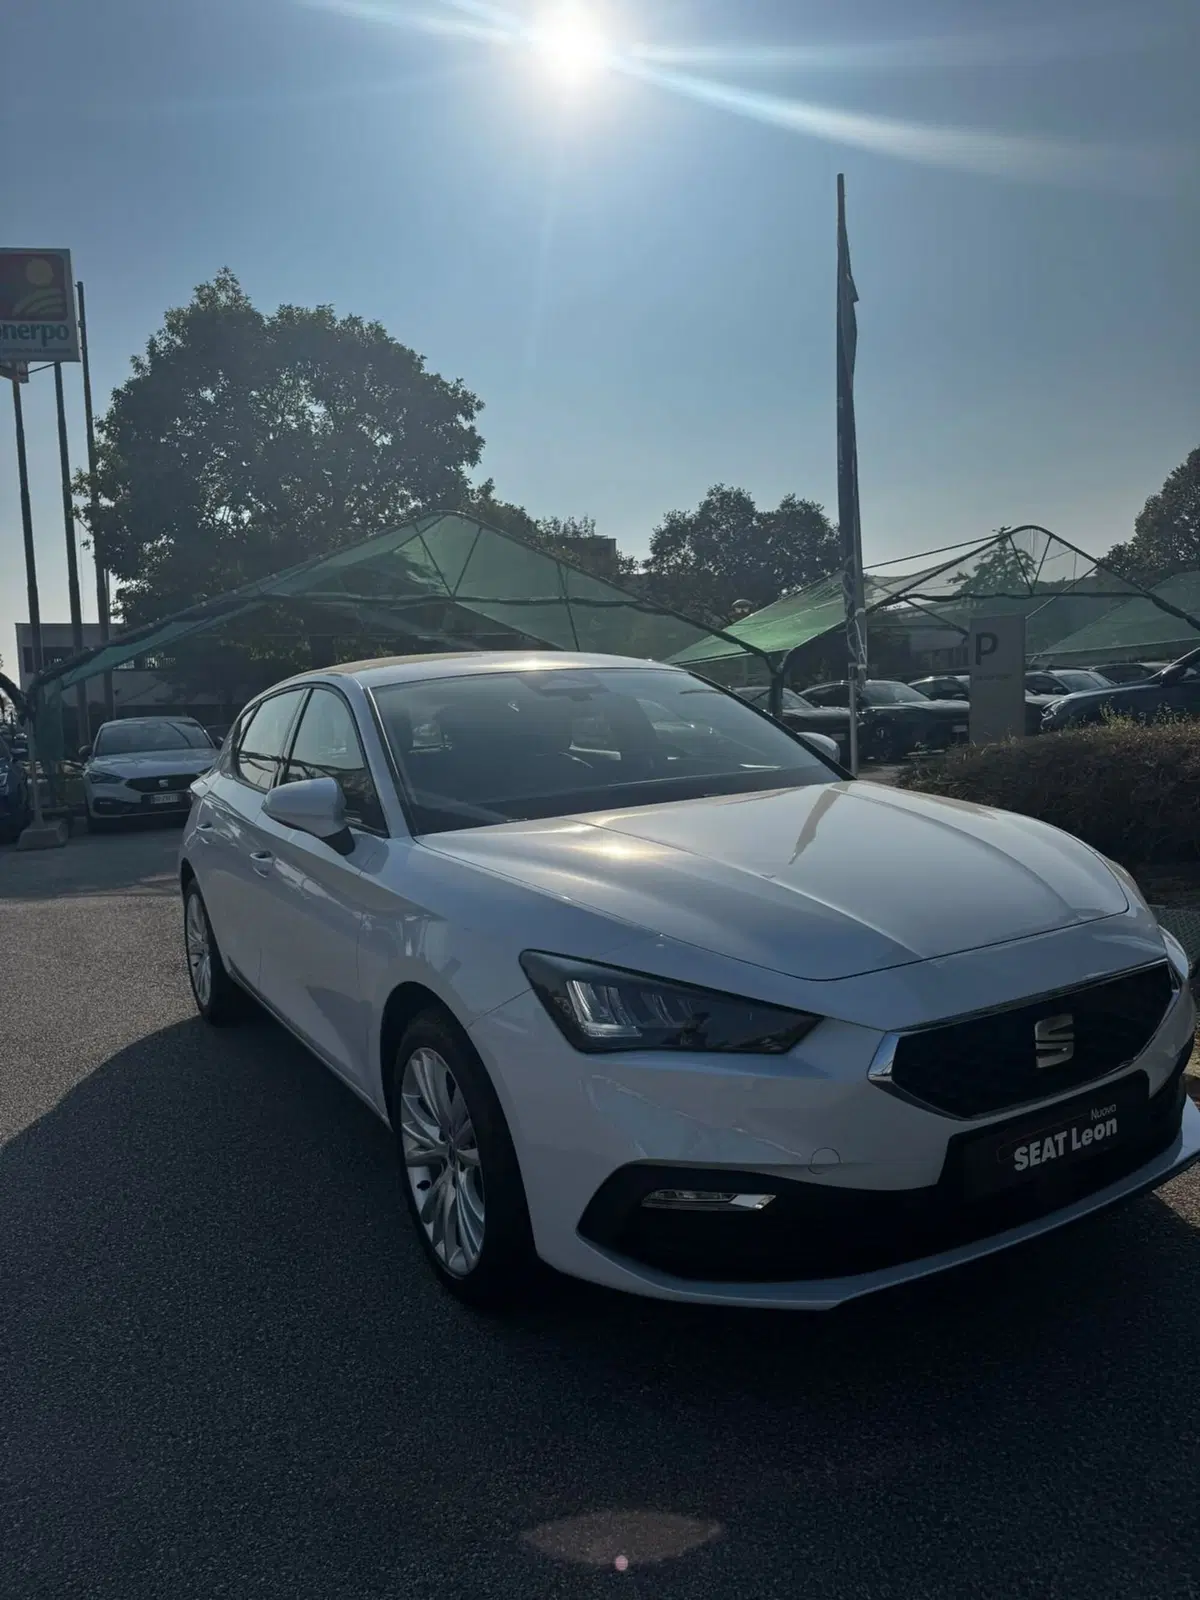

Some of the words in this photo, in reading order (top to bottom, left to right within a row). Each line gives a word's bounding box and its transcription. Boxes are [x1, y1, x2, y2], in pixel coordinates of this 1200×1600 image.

[0, 323, 70, 347] nerpo
[975, 632, 999, 665] P
[1014, 1131, 1067, 1171] SEAT
[1072, 1118, 1118, 1151] Leon
